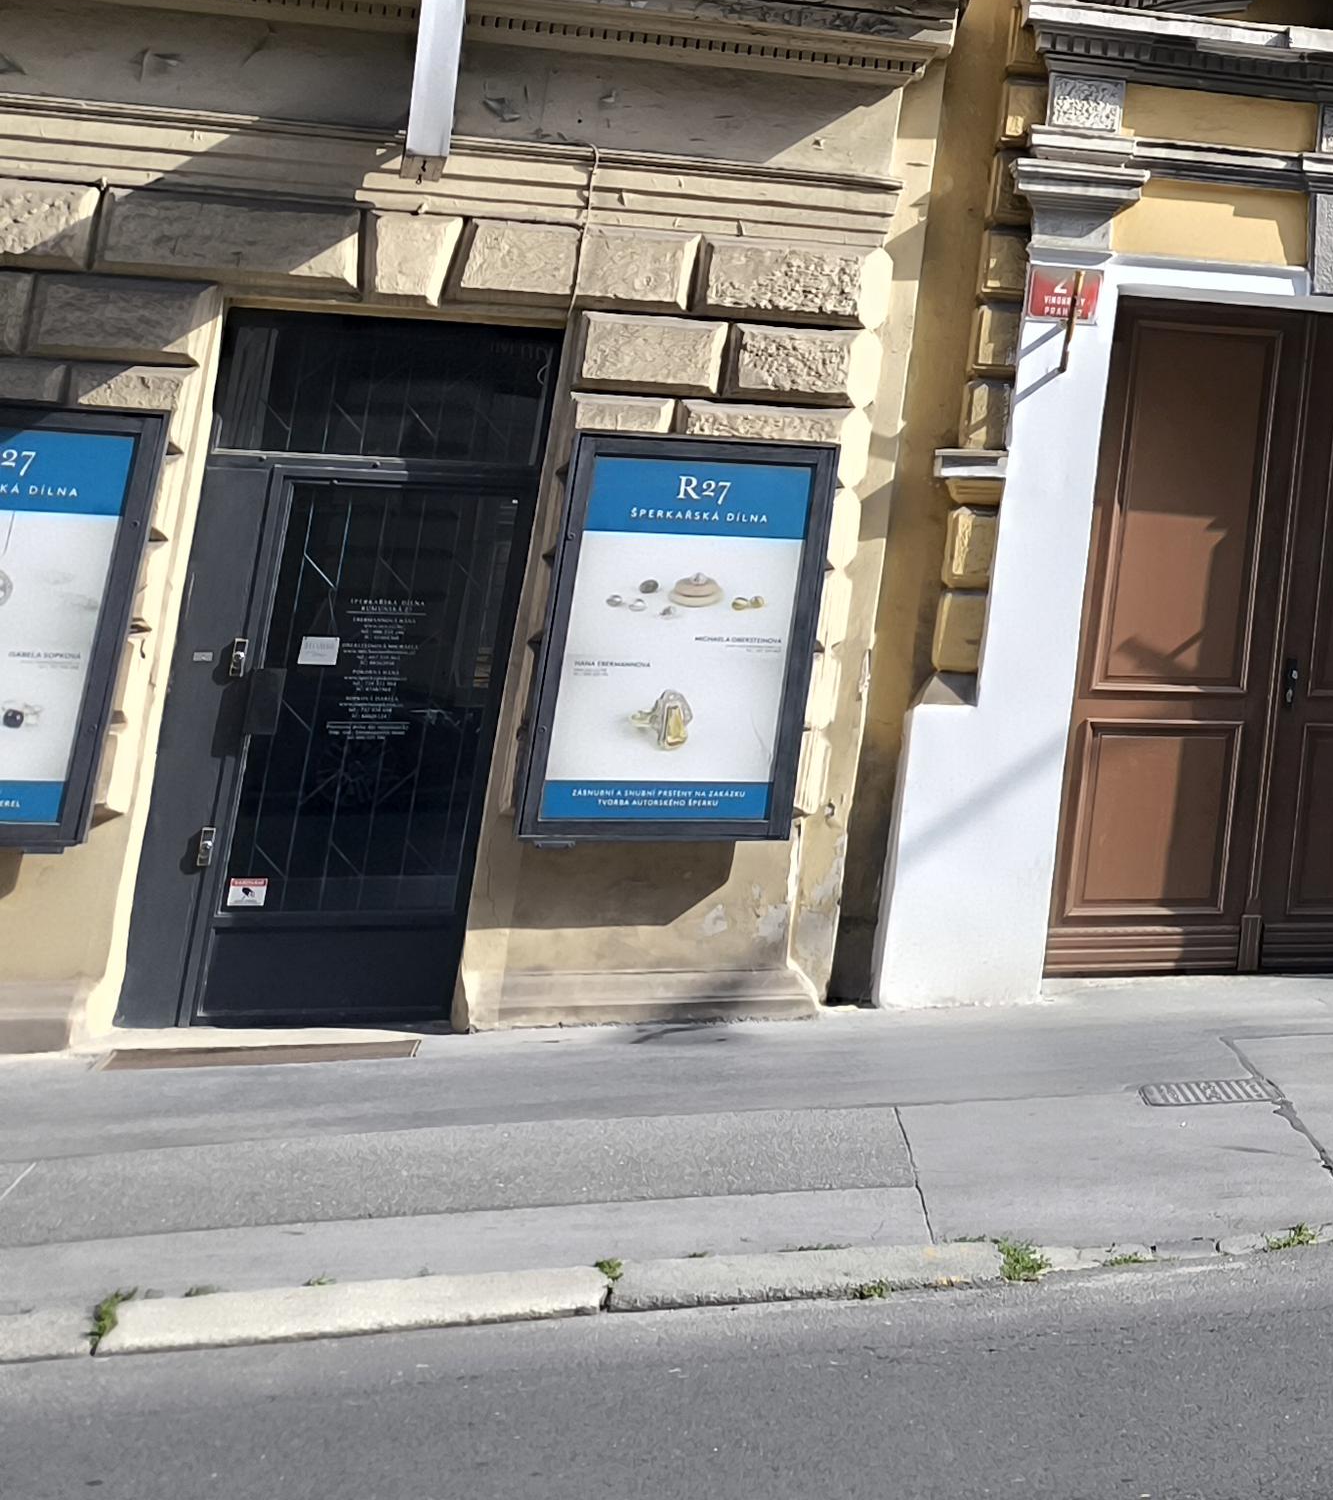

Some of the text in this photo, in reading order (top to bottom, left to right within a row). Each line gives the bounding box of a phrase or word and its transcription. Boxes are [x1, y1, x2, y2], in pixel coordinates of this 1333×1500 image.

[1044, 295, 1086, 307] VINOHRY
[1044, 306, 1069, 317] PRAH
[0, 449, 36, 477] 27
[29, 483, 78, 497] DÍLNA
[676, 475, 732, 505] R27
[630, 506, 768, 524] ŠPERKAŘSKÁ DÍLNA
[597, 798, 629, 806] TVORBA
